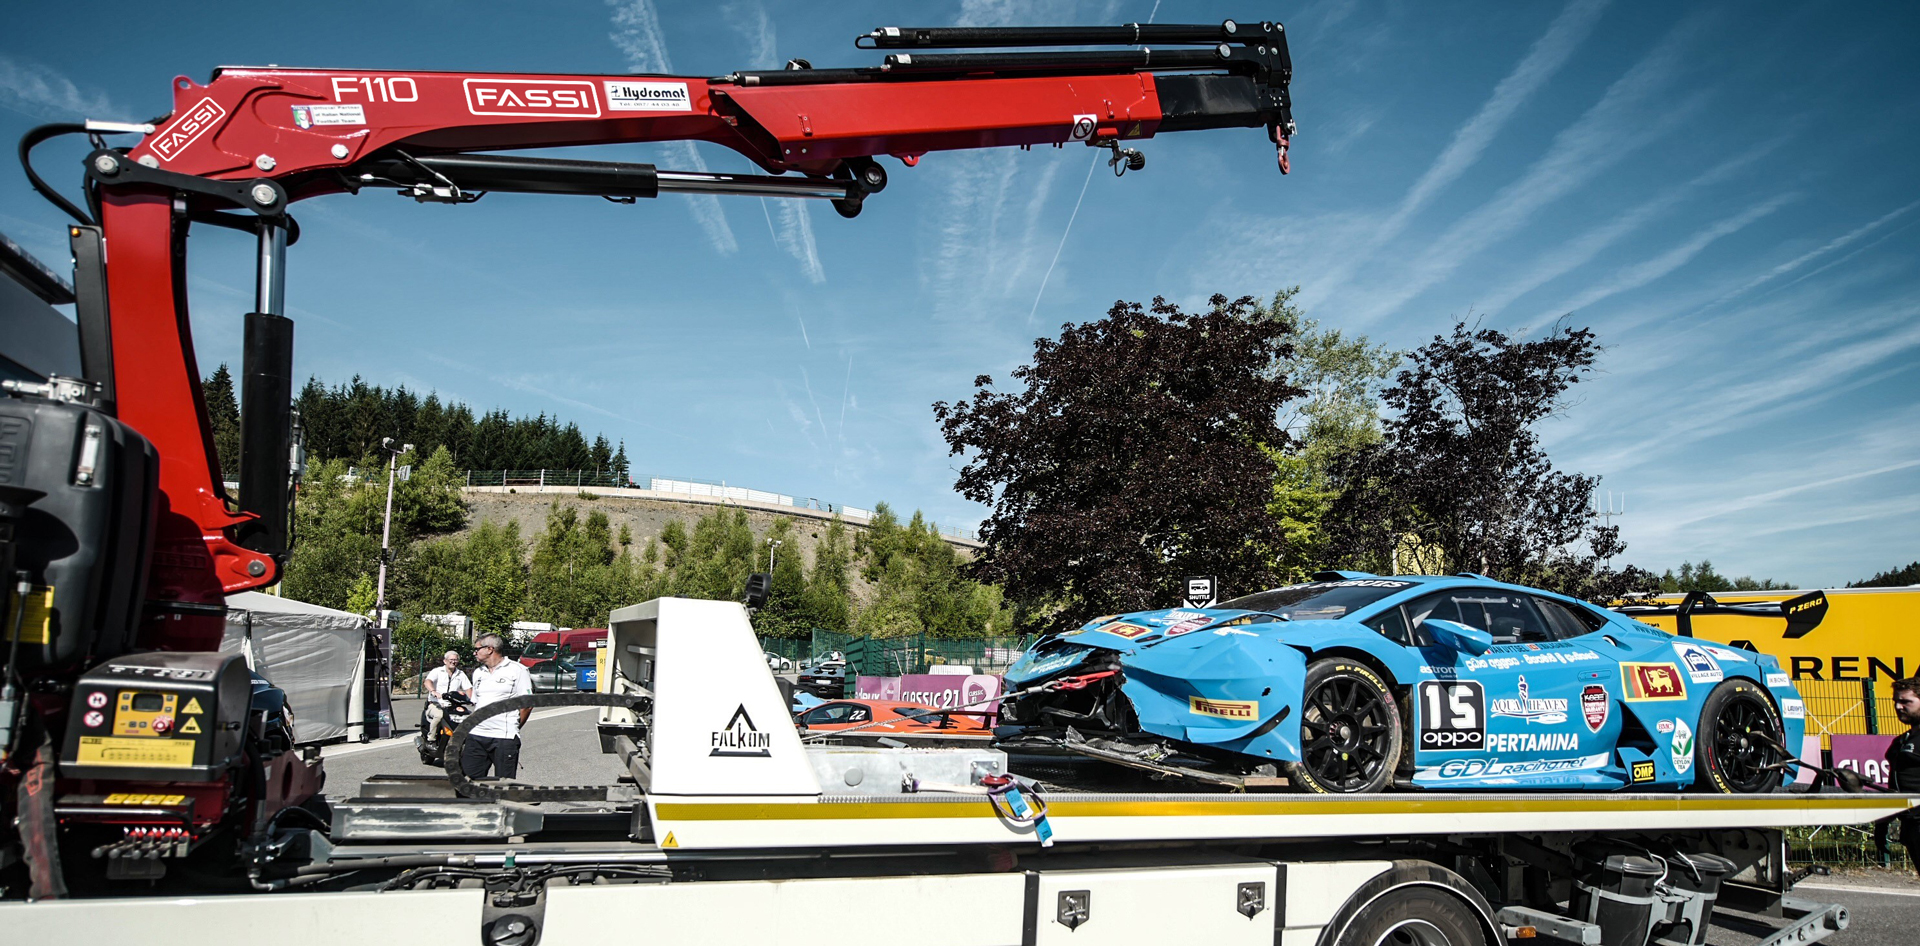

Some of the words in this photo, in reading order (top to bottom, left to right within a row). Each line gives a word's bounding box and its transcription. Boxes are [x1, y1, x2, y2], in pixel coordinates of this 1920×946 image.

[331, 77, 418, 102] F110
[475, 88, 589, 108] FASSI
[622, 86, 686, 100] Hydromat
[158, 104, 217, 155] FASSI
[1789, 606, 1797, 615] P
[1797, 597, 1824, 612] ZERO
[1790, 656, 1920, 681] REN
[1353, 666, 1386, 693] PIRELLI
[943, 689, 960, 712] 21
[1195, 699, 1251, 717] PIRELLI
[1425, 684, 1477, 730] 15
[1490, 698, 1519, 713] AQUA
[849, 710, 866, 721] 22
[711, 722, 770, 749] FALKOM
[1423, 731, 1482, 747] oppo
[1486, 733, 1579, 752] PERTAMINA
[1633, 765, 1654, 779] OMP
[1837, 759, 1890, 784] CLAS
